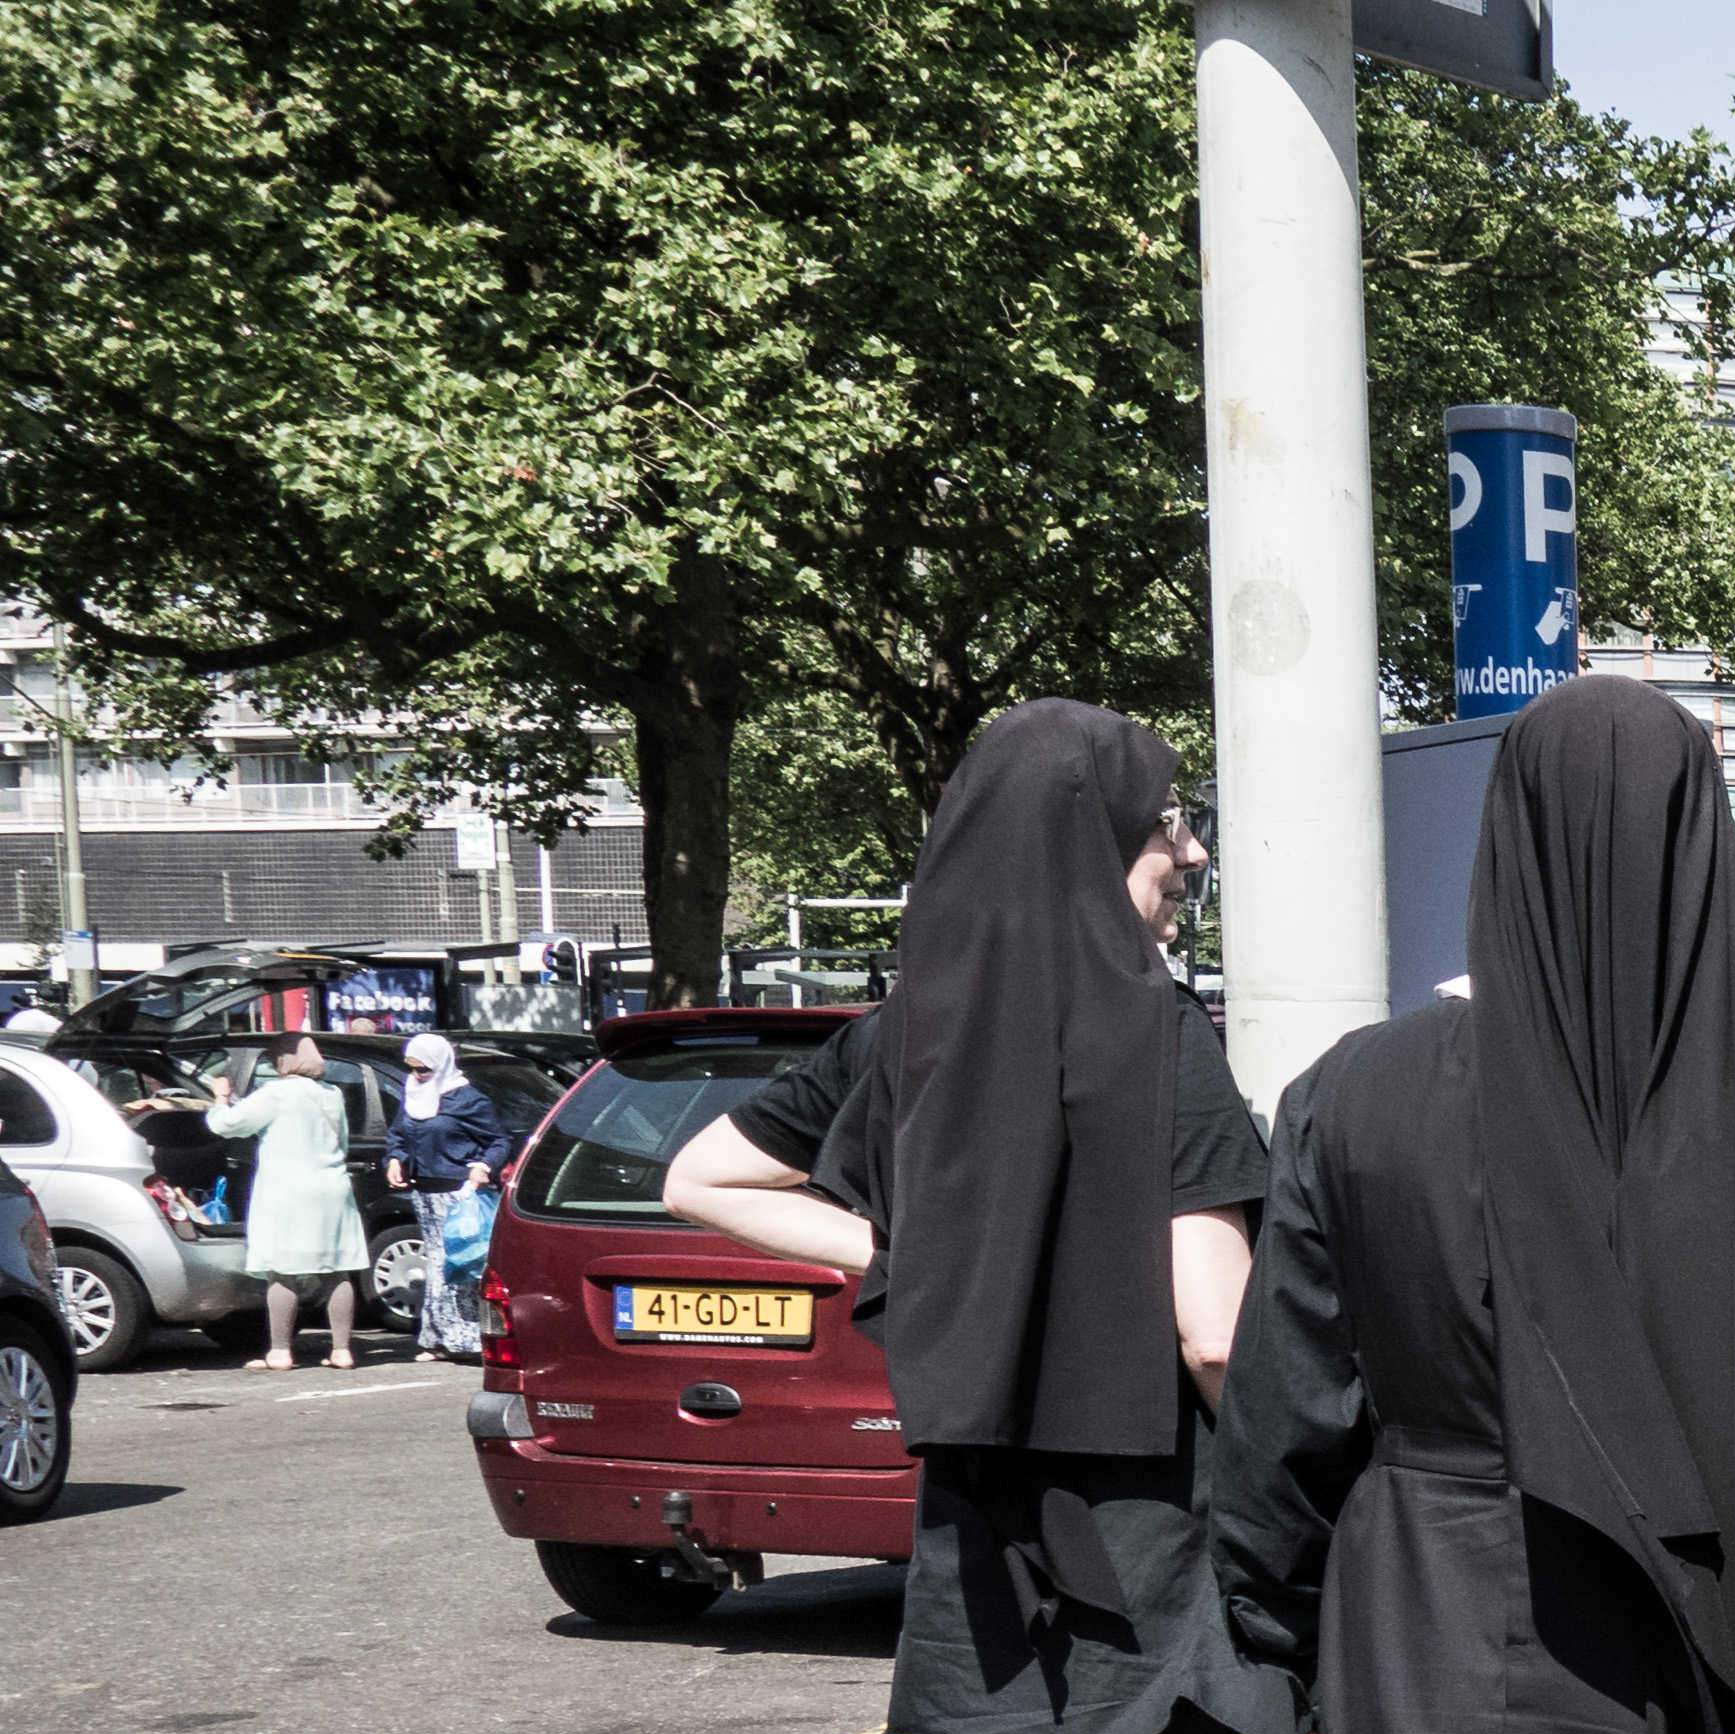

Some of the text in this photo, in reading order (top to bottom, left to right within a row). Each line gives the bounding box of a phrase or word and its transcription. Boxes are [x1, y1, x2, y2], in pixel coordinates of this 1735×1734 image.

[1522, 450, 1575, 563] P
[327, 990, 434, 1012] Facebook
[648, 1294, 793, 1328] 41-GD-LT
